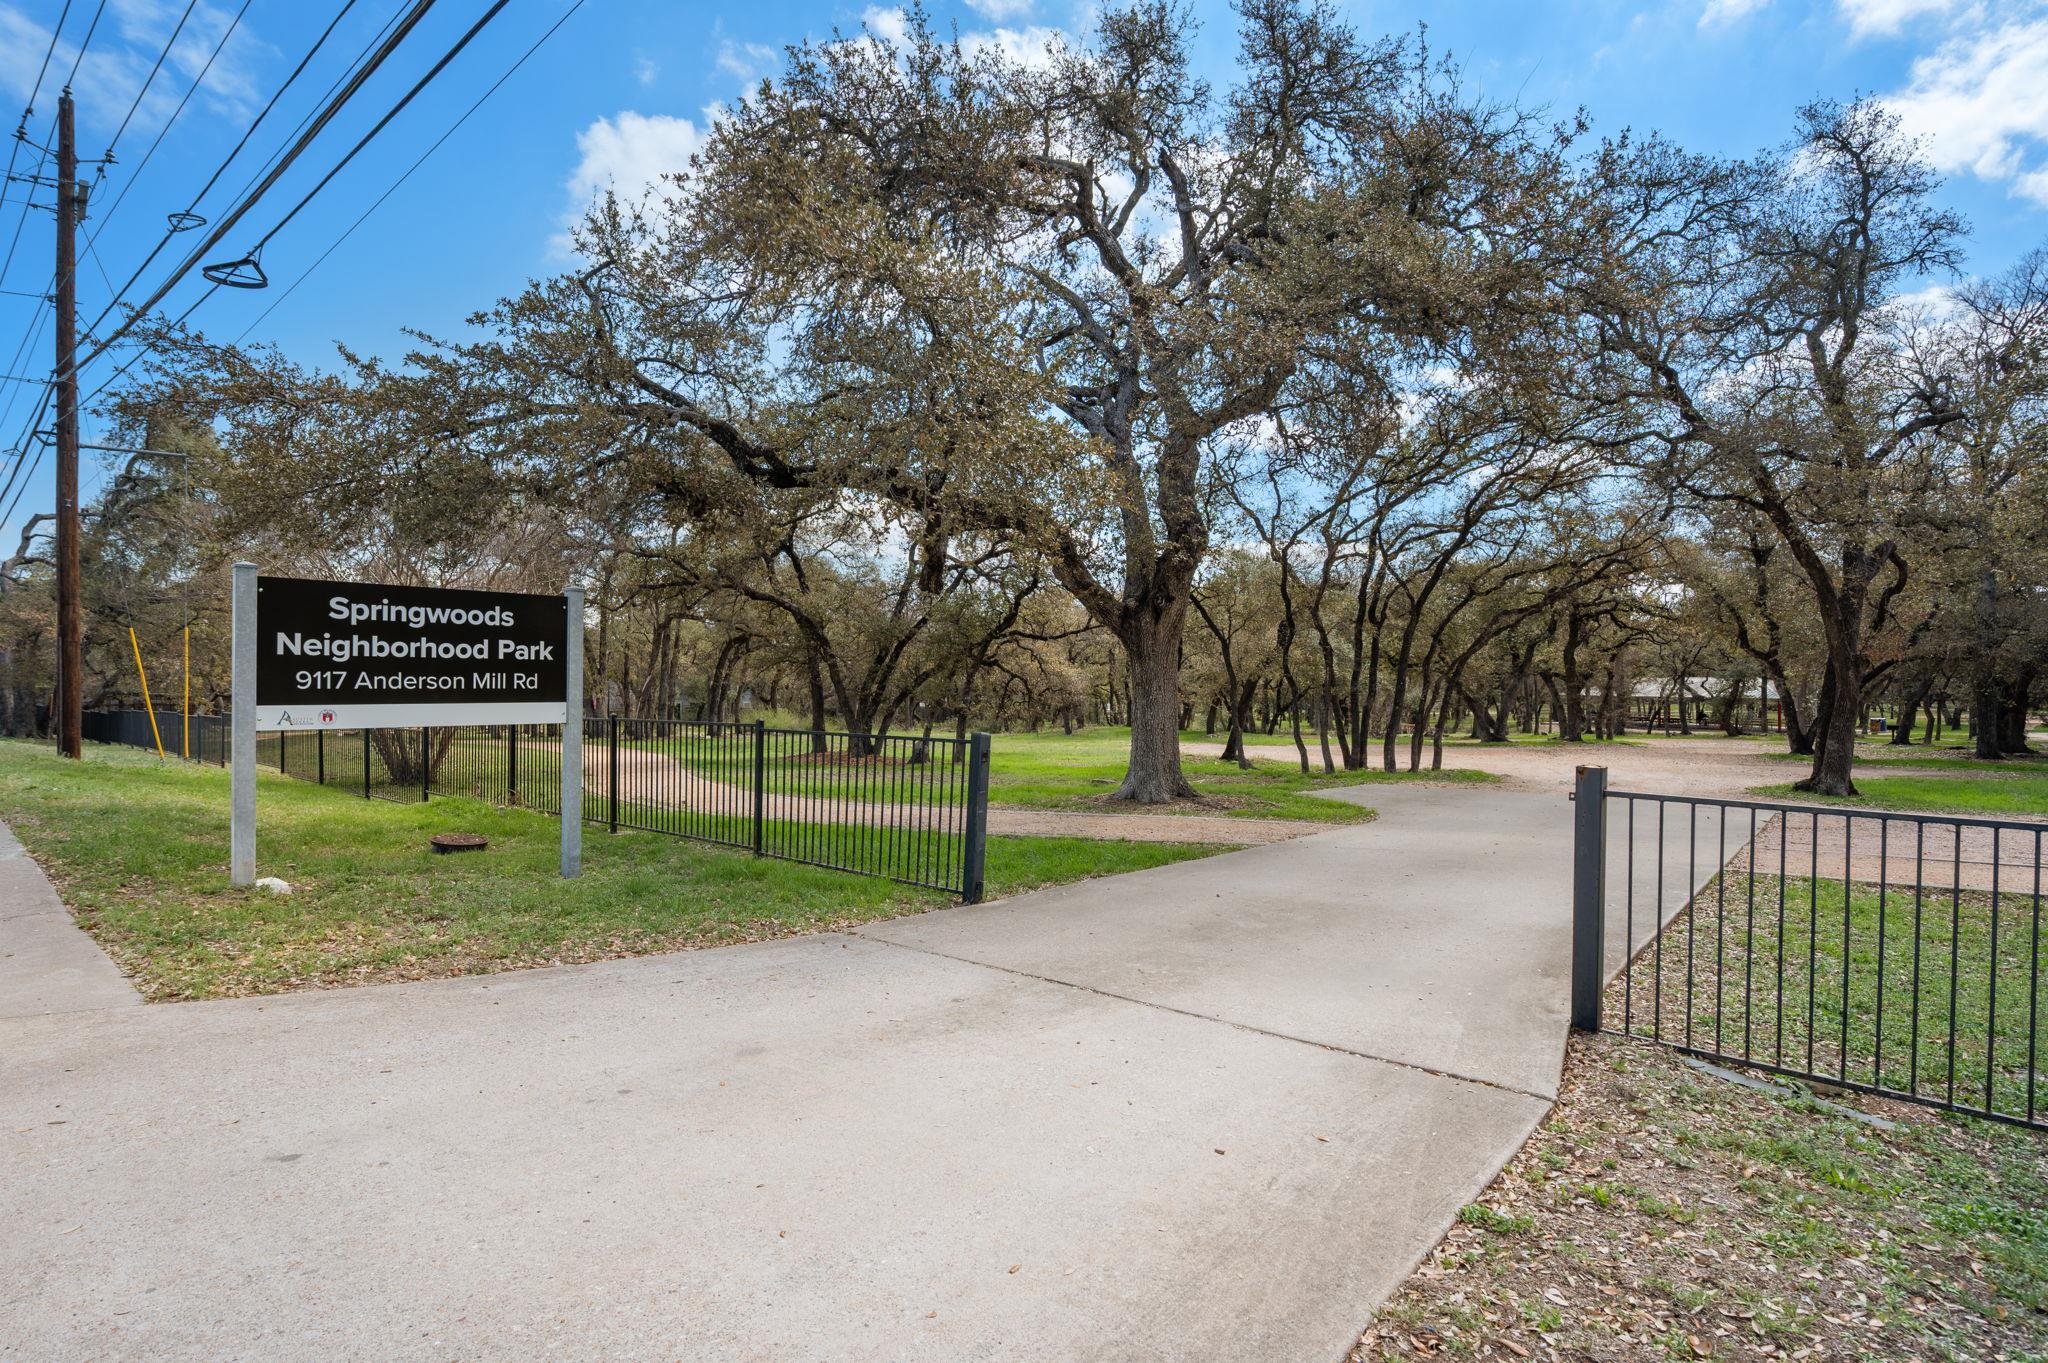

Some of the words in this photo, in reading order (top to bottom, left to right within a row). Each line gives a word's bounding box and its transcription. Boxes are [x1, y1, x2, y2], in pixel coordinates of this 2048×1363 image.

[329, 597, 514, 627] Springwoods
[277, 632, 488, 662] Neighborhood
[499, 640, 554, 662] Park
[296, 671, 347, 690] 9117
[354, 671, 465, 690] Anderson
[473, 673, 506, 690] Mill
[514, 673, 538, 690] Rd
